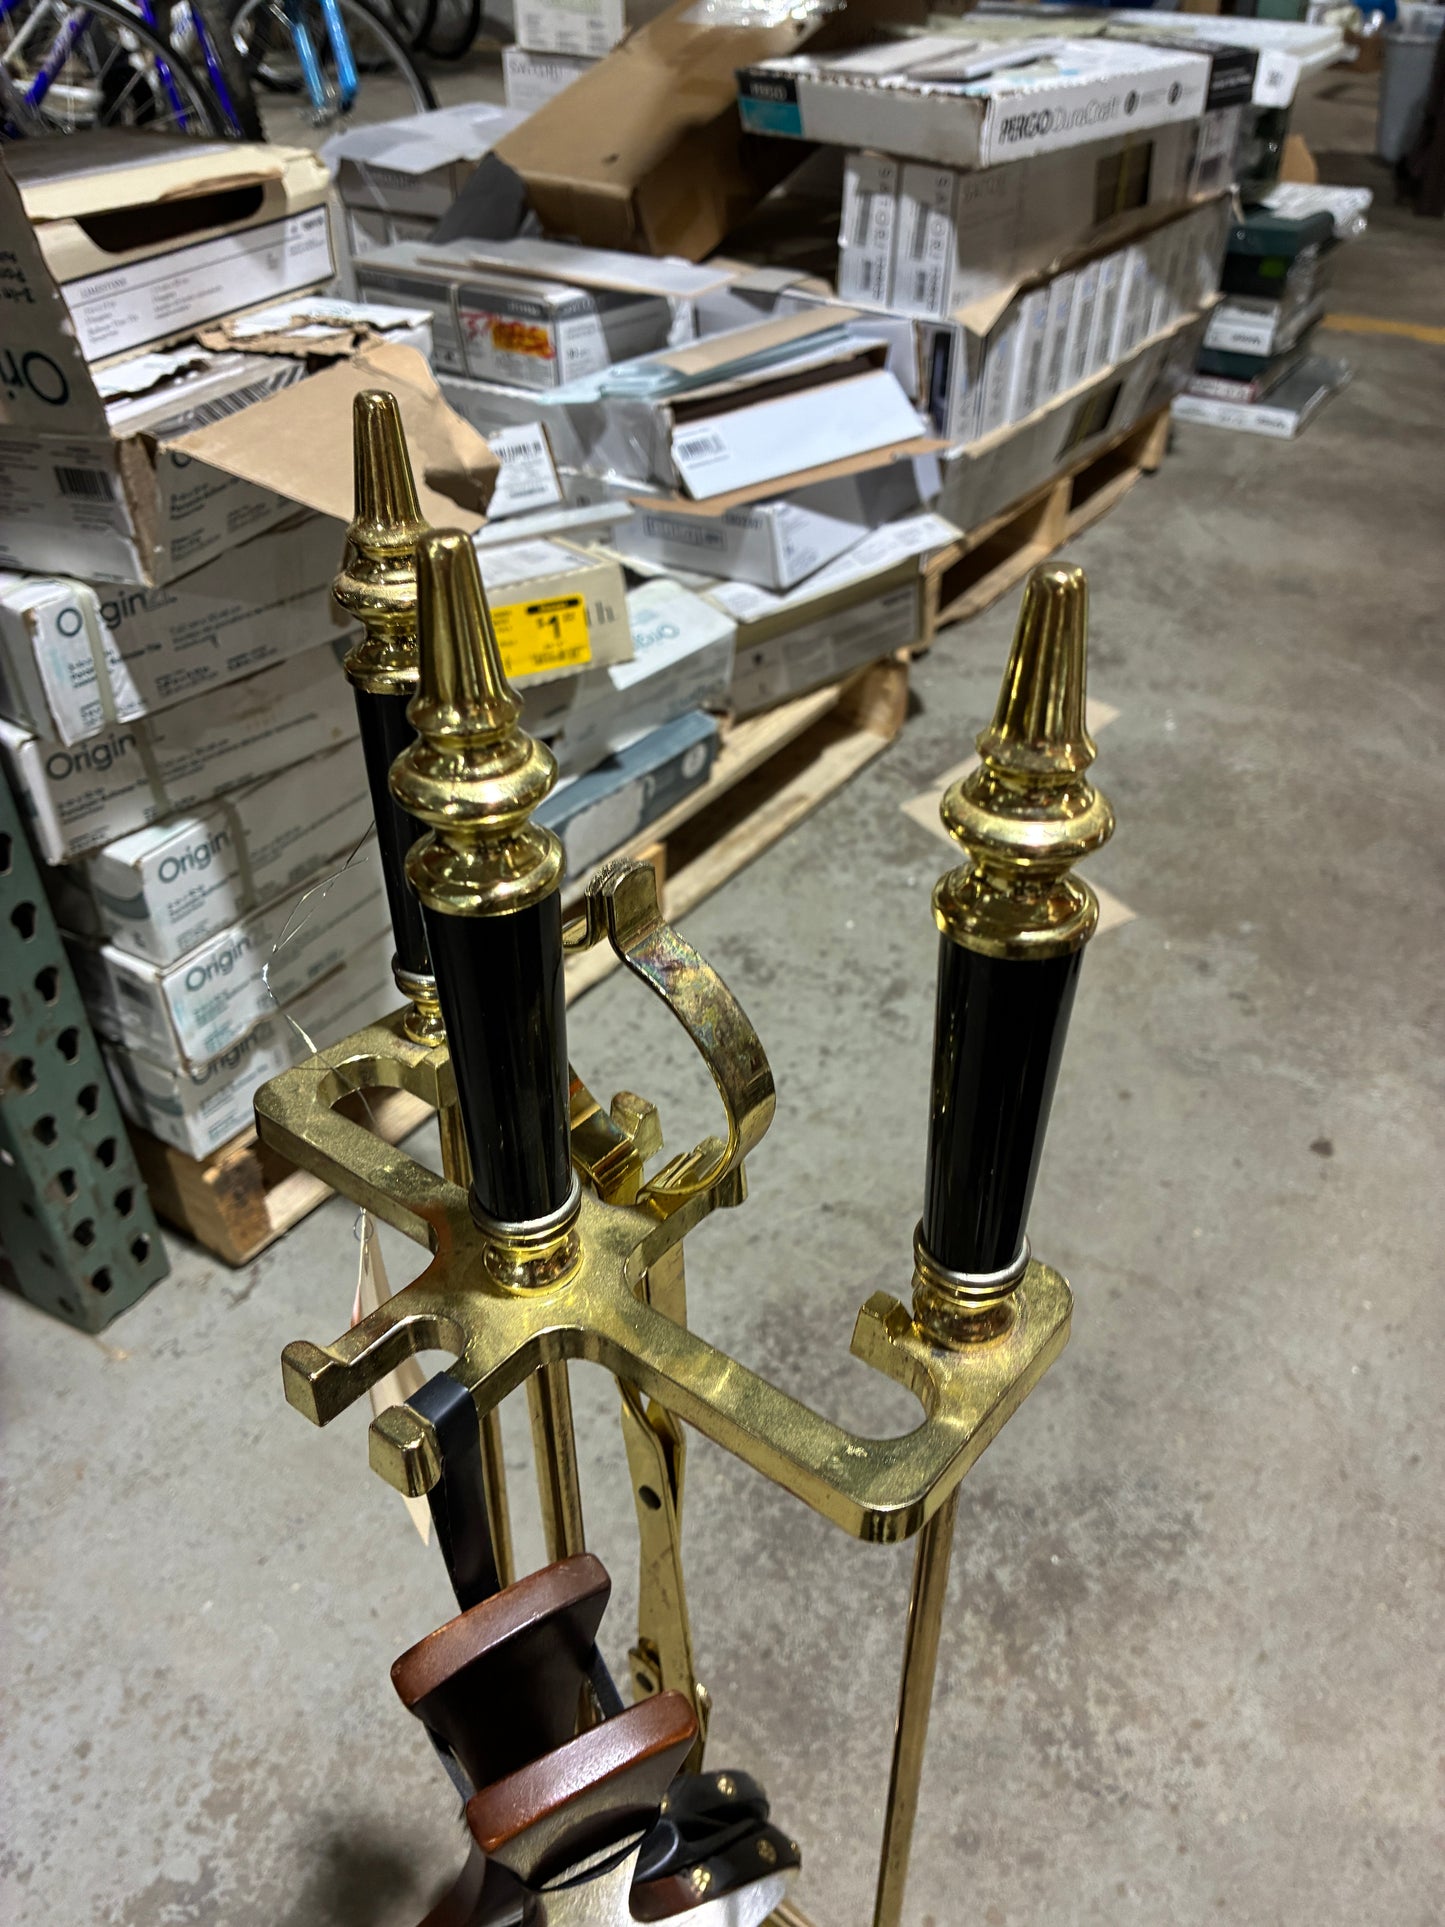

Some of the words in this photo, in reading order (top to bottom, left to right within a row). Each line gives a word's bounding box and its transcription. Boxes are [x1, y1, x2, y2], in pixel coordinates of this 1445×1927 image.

[46, 732, 136, 780] Origin
[158, 829, 231, 883] Origin
[185, 935, 250, 992] Origin
